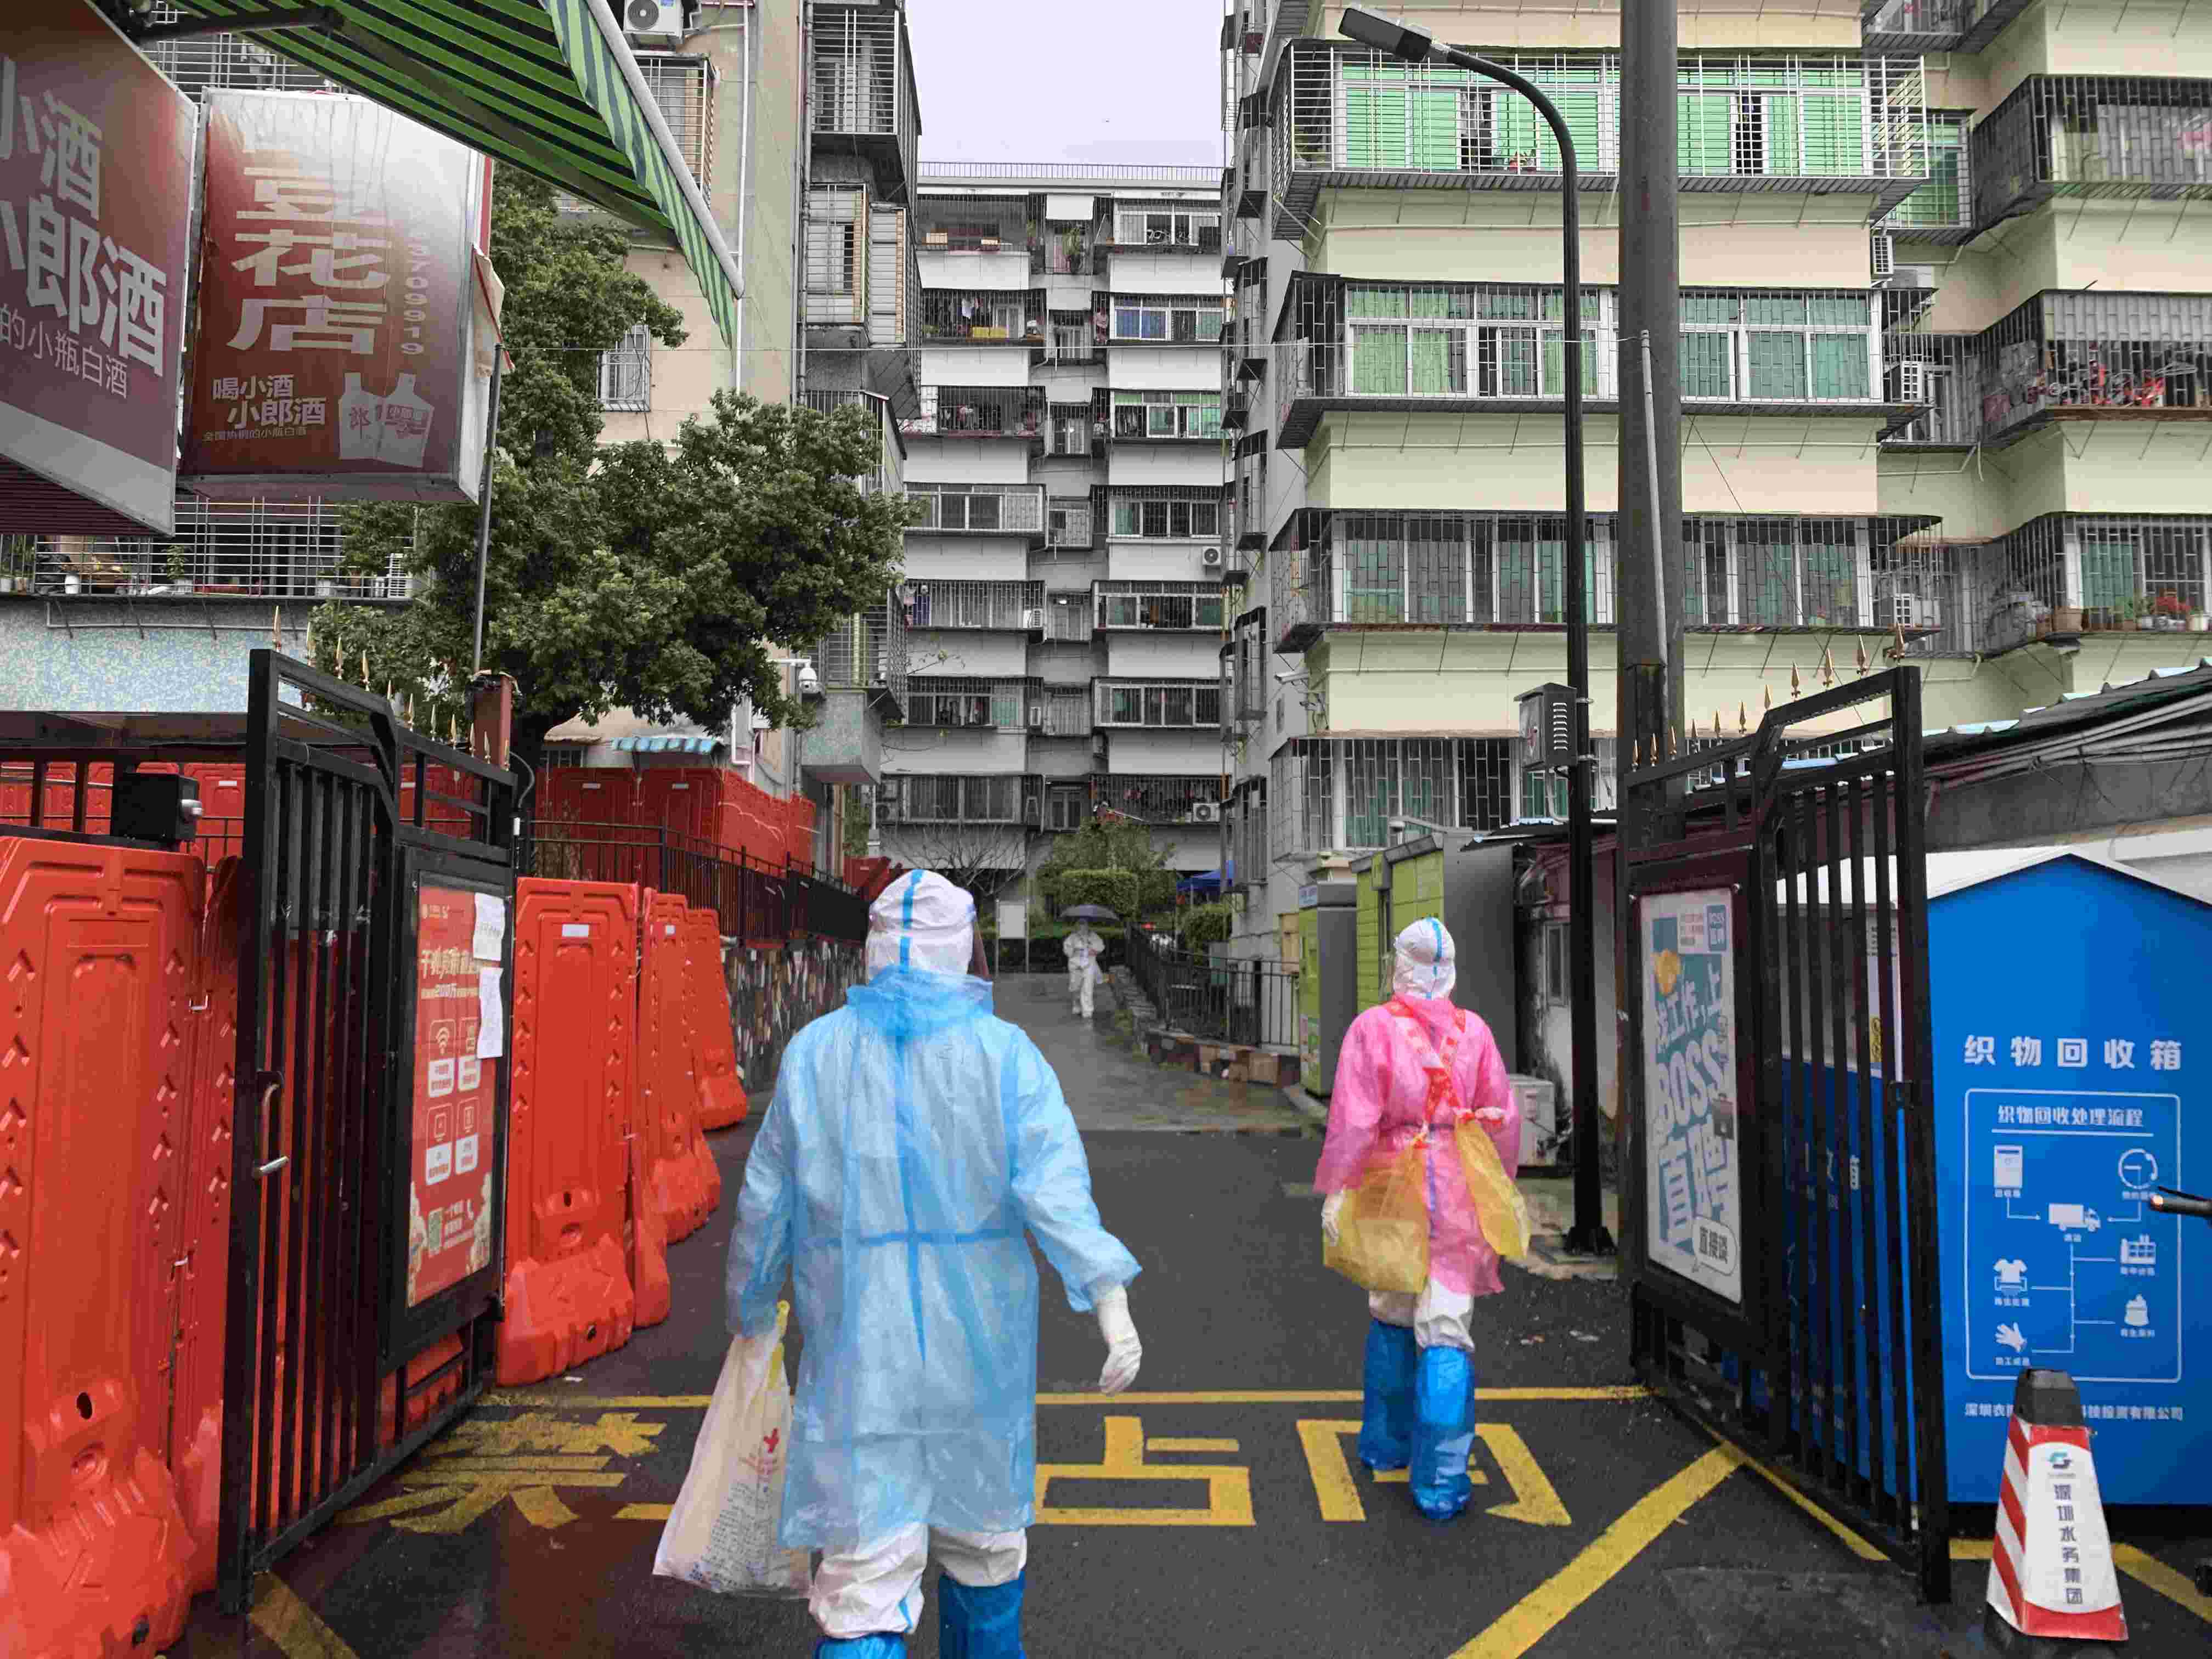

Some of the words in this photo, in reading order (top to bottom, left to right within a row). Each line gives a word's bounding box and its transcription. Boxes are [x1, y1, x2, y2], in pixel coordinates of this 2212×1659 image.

[0, 193, 167, 377] 郎酒
[212, 374, 295, 400] 喝小酒
[227, 396, 327, 430] 小郎酒
[1963, 1034, 2182, 1071] 织物回收箱
[1655, 1028, 1723, 1147] BOSS
[1997, 1104, 2143, 1127] 织物回收处理流程
[2053, 1483, 2084, 1605] 深圳水务集团
